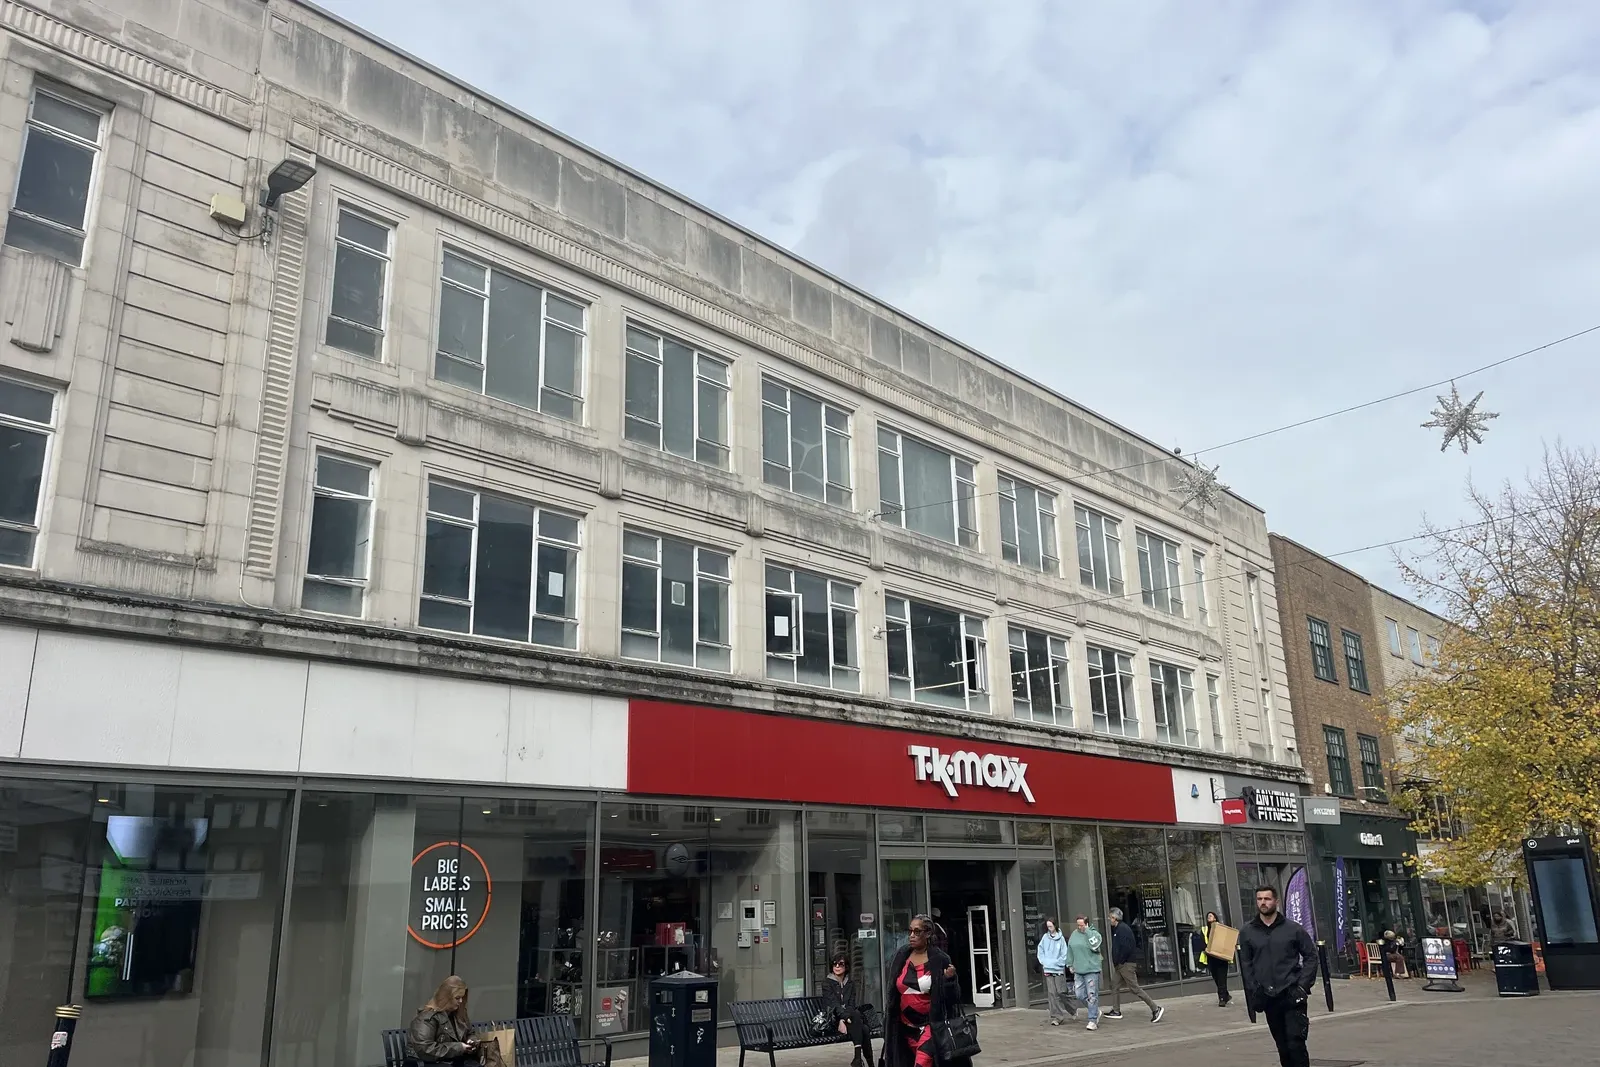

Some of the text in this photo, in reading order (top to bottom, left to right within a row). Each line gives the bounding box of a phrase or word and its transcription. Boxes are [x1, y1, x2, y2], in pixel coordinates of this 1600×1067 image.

[1255, 788, 1298, 809] ANYTIME
[1257, 806, 1299, 823] FITNESS
[437, 859, 459, 874] BIG
[1144, 887, 1161, 898] DEALS
[1145, 899, 1162, 908] TO THE
[1146, 908, 1163, 918] MAXX
